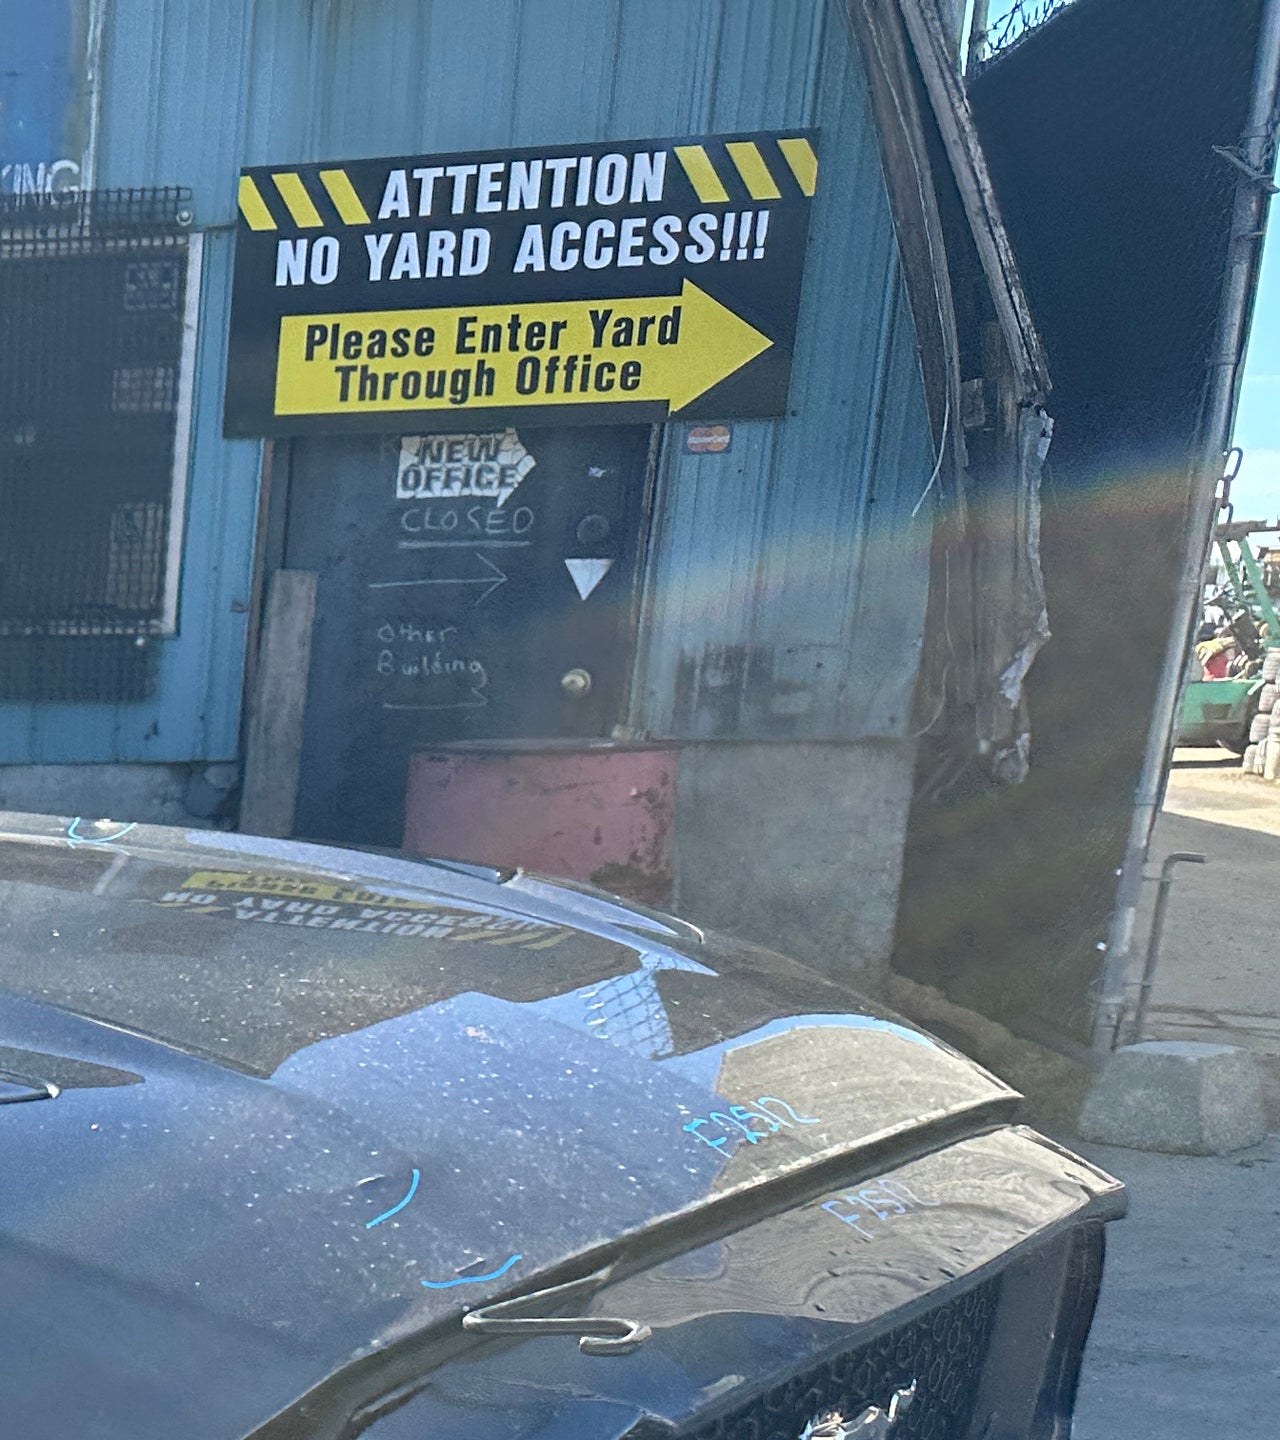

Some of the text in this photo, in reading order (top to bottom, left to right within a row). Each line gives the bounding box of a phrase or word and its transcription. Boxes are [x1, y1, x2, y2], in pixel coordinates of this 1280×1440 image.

[377, 151, 668, 220] ATTENTION
[275, 209, 770, 287] NO YARD ACCESS!!!
[304, 305, 683, 362] Please Enter Yard
[335, 357, 643, 405] Through Office
[415, 436, 500, 465] NEW
[400, 463, 517, 492] OFFICE
